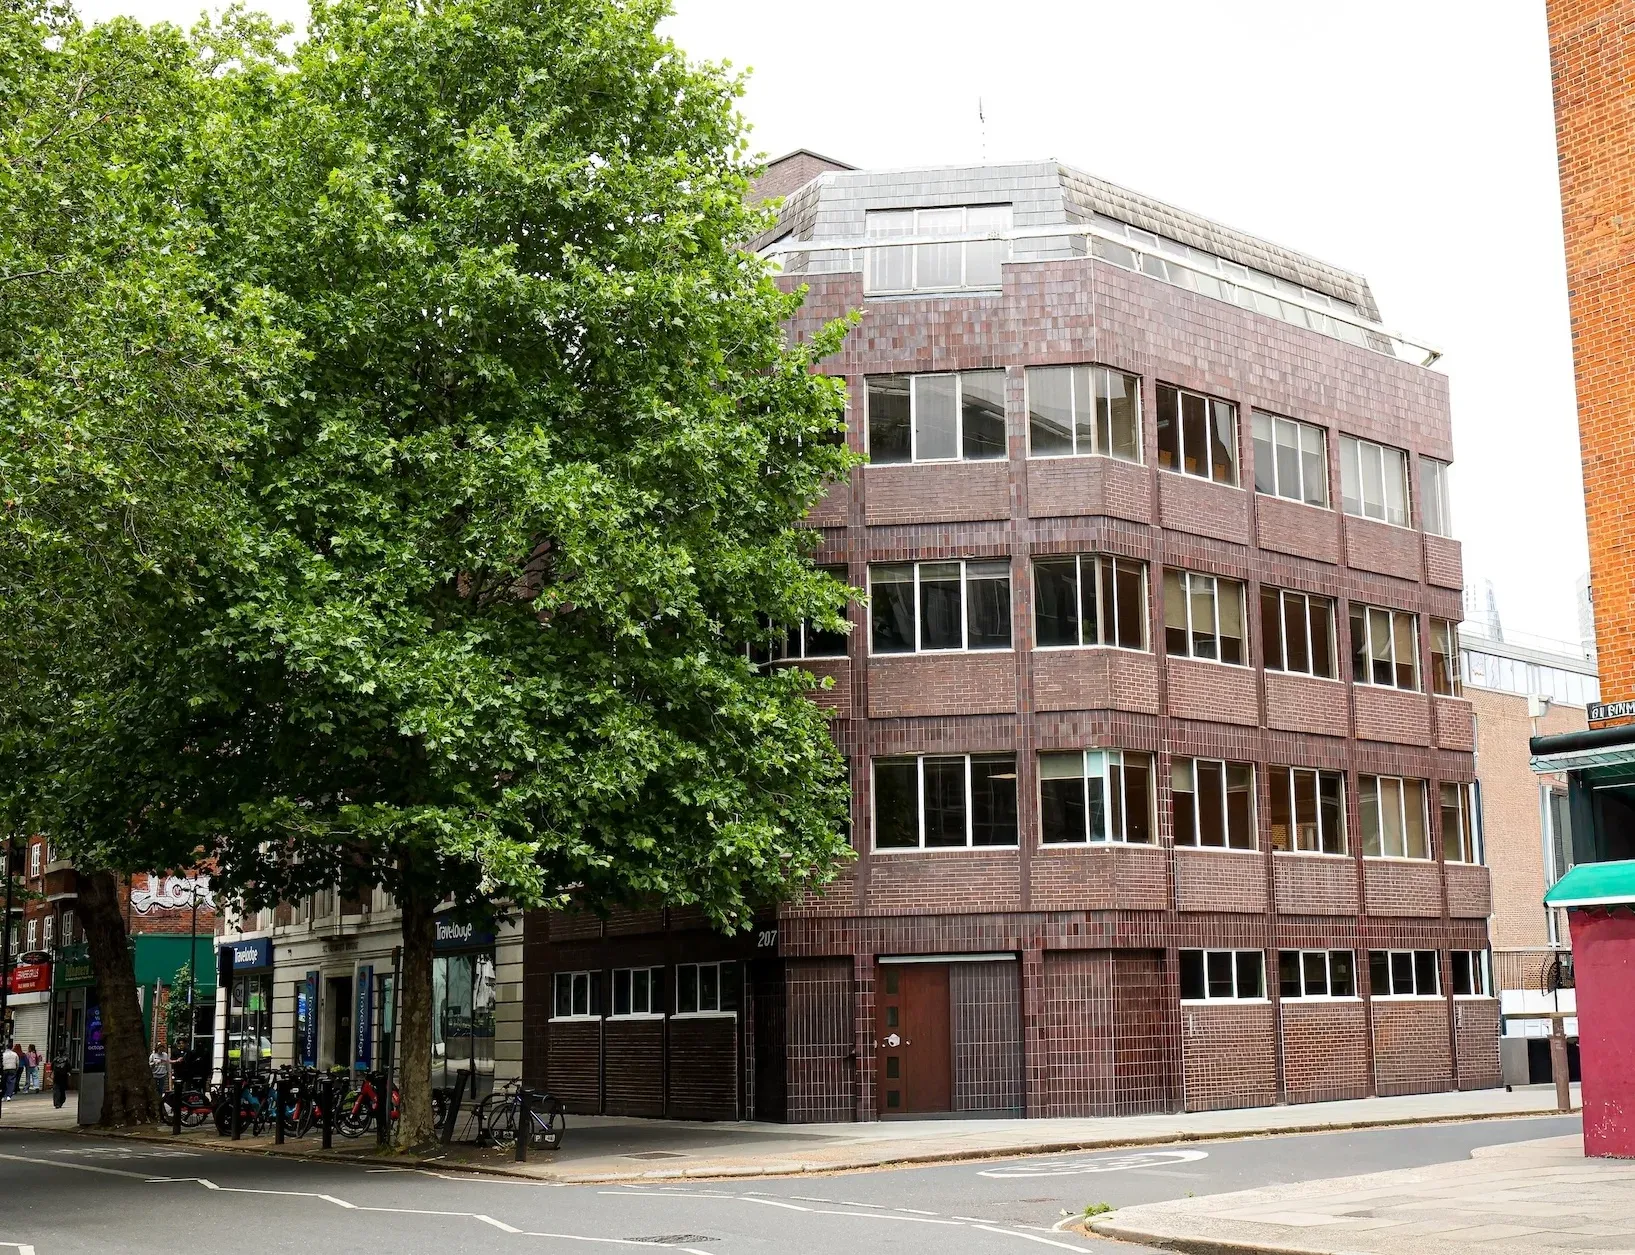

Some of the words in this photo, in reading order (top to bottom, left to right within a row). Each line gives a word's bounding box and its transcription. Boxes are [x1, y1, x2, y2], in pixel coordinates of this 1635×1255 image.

[757, 930, 778, 948] 207
[233, 945, 259, 965] Travelodge
[358, 991, 367, 1057] Travelodge
